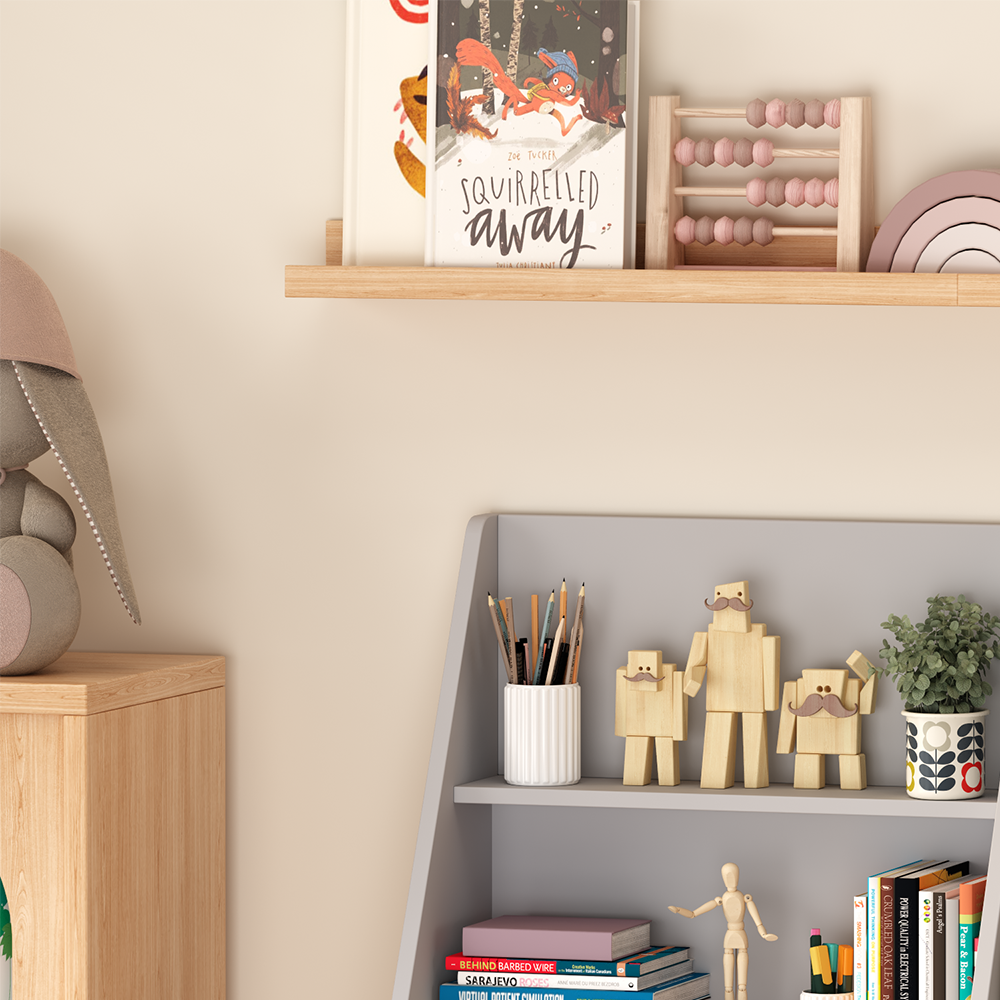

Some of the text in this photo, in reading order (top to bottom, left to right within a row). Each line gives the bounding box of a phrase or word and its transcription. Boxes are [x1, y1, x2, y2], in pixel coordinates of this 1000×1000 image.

[528, 150, 557, 160] TUCKER
[461, 168, 598, 214] SQUIRRELLED
[465, 206, 596, 269] away
[899, 897, 909, 918] POWER
[883, 895, 893, 989] CRUMBLED OAK LEAF
[898, 919, 909, 947] QUALITY
[460, 961, 554, 972] BEHIND BARBED WIRE
[899, 954, 908, 991] ELECTRICAL
[960, 926, 968, 990] Pear & Bacon
[465, 976, 549, 987] SARAJEVO ROSES
